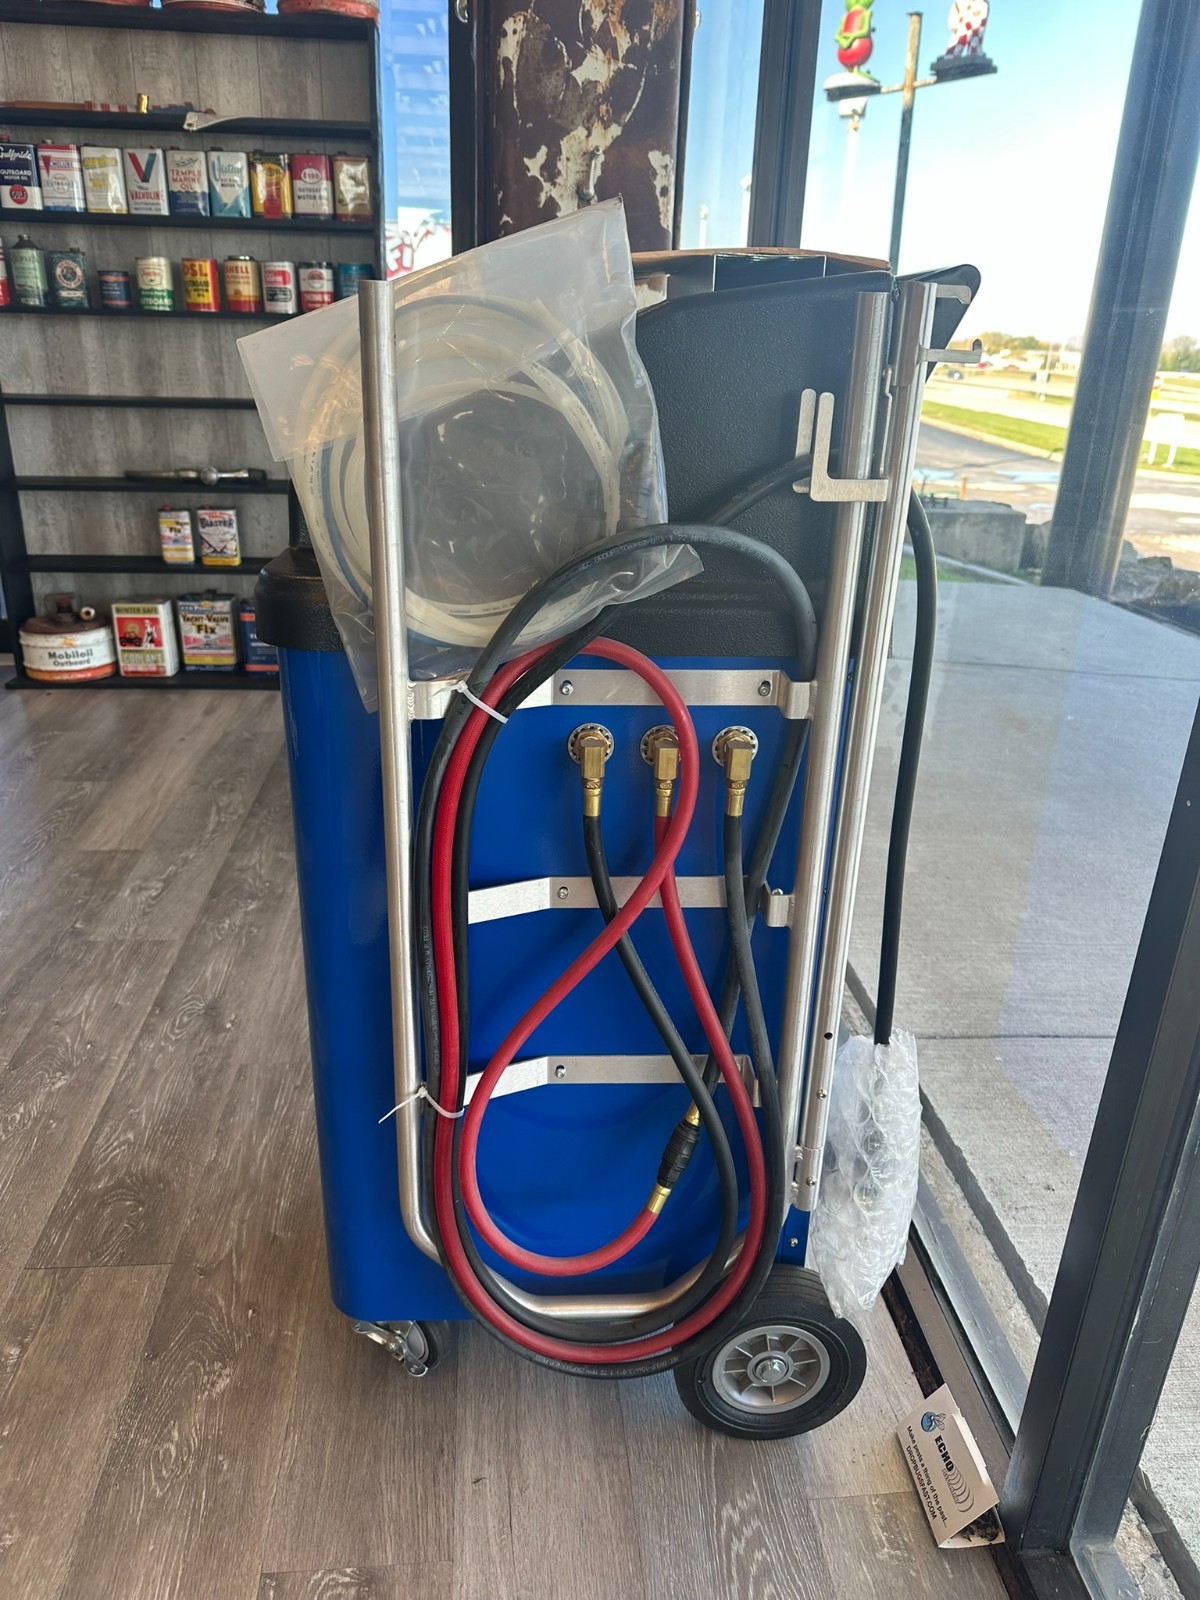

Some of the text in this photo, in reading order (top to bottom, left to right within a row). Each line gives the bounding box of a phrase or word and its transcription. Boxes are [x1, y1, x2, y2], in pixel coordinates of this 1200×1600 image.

[170, 168, 201, 177] TEMPLE
[171, 176, 201, 184] MARINE
[225, 264, 250, 274] SHELL
[114, 606, 159, 614] WINTER SAFE
[47, 648, 93, 660] Mobiloil
[123, 652, 162, 663] COOLANT
[52, 658, 91, 667] Outboard
[907, 1425, 917, 1444] Make
[913, 1444, 924, 1463] pests
[934, 1435, 954, 1473] ECHO
[922, 1467, 932, 1485] thing
[906, 1445, 938, 1521] DROPBUGSFAST.COM
[930, 1484, 937, 1494] of
[933, 1493, 941, 1505] the
